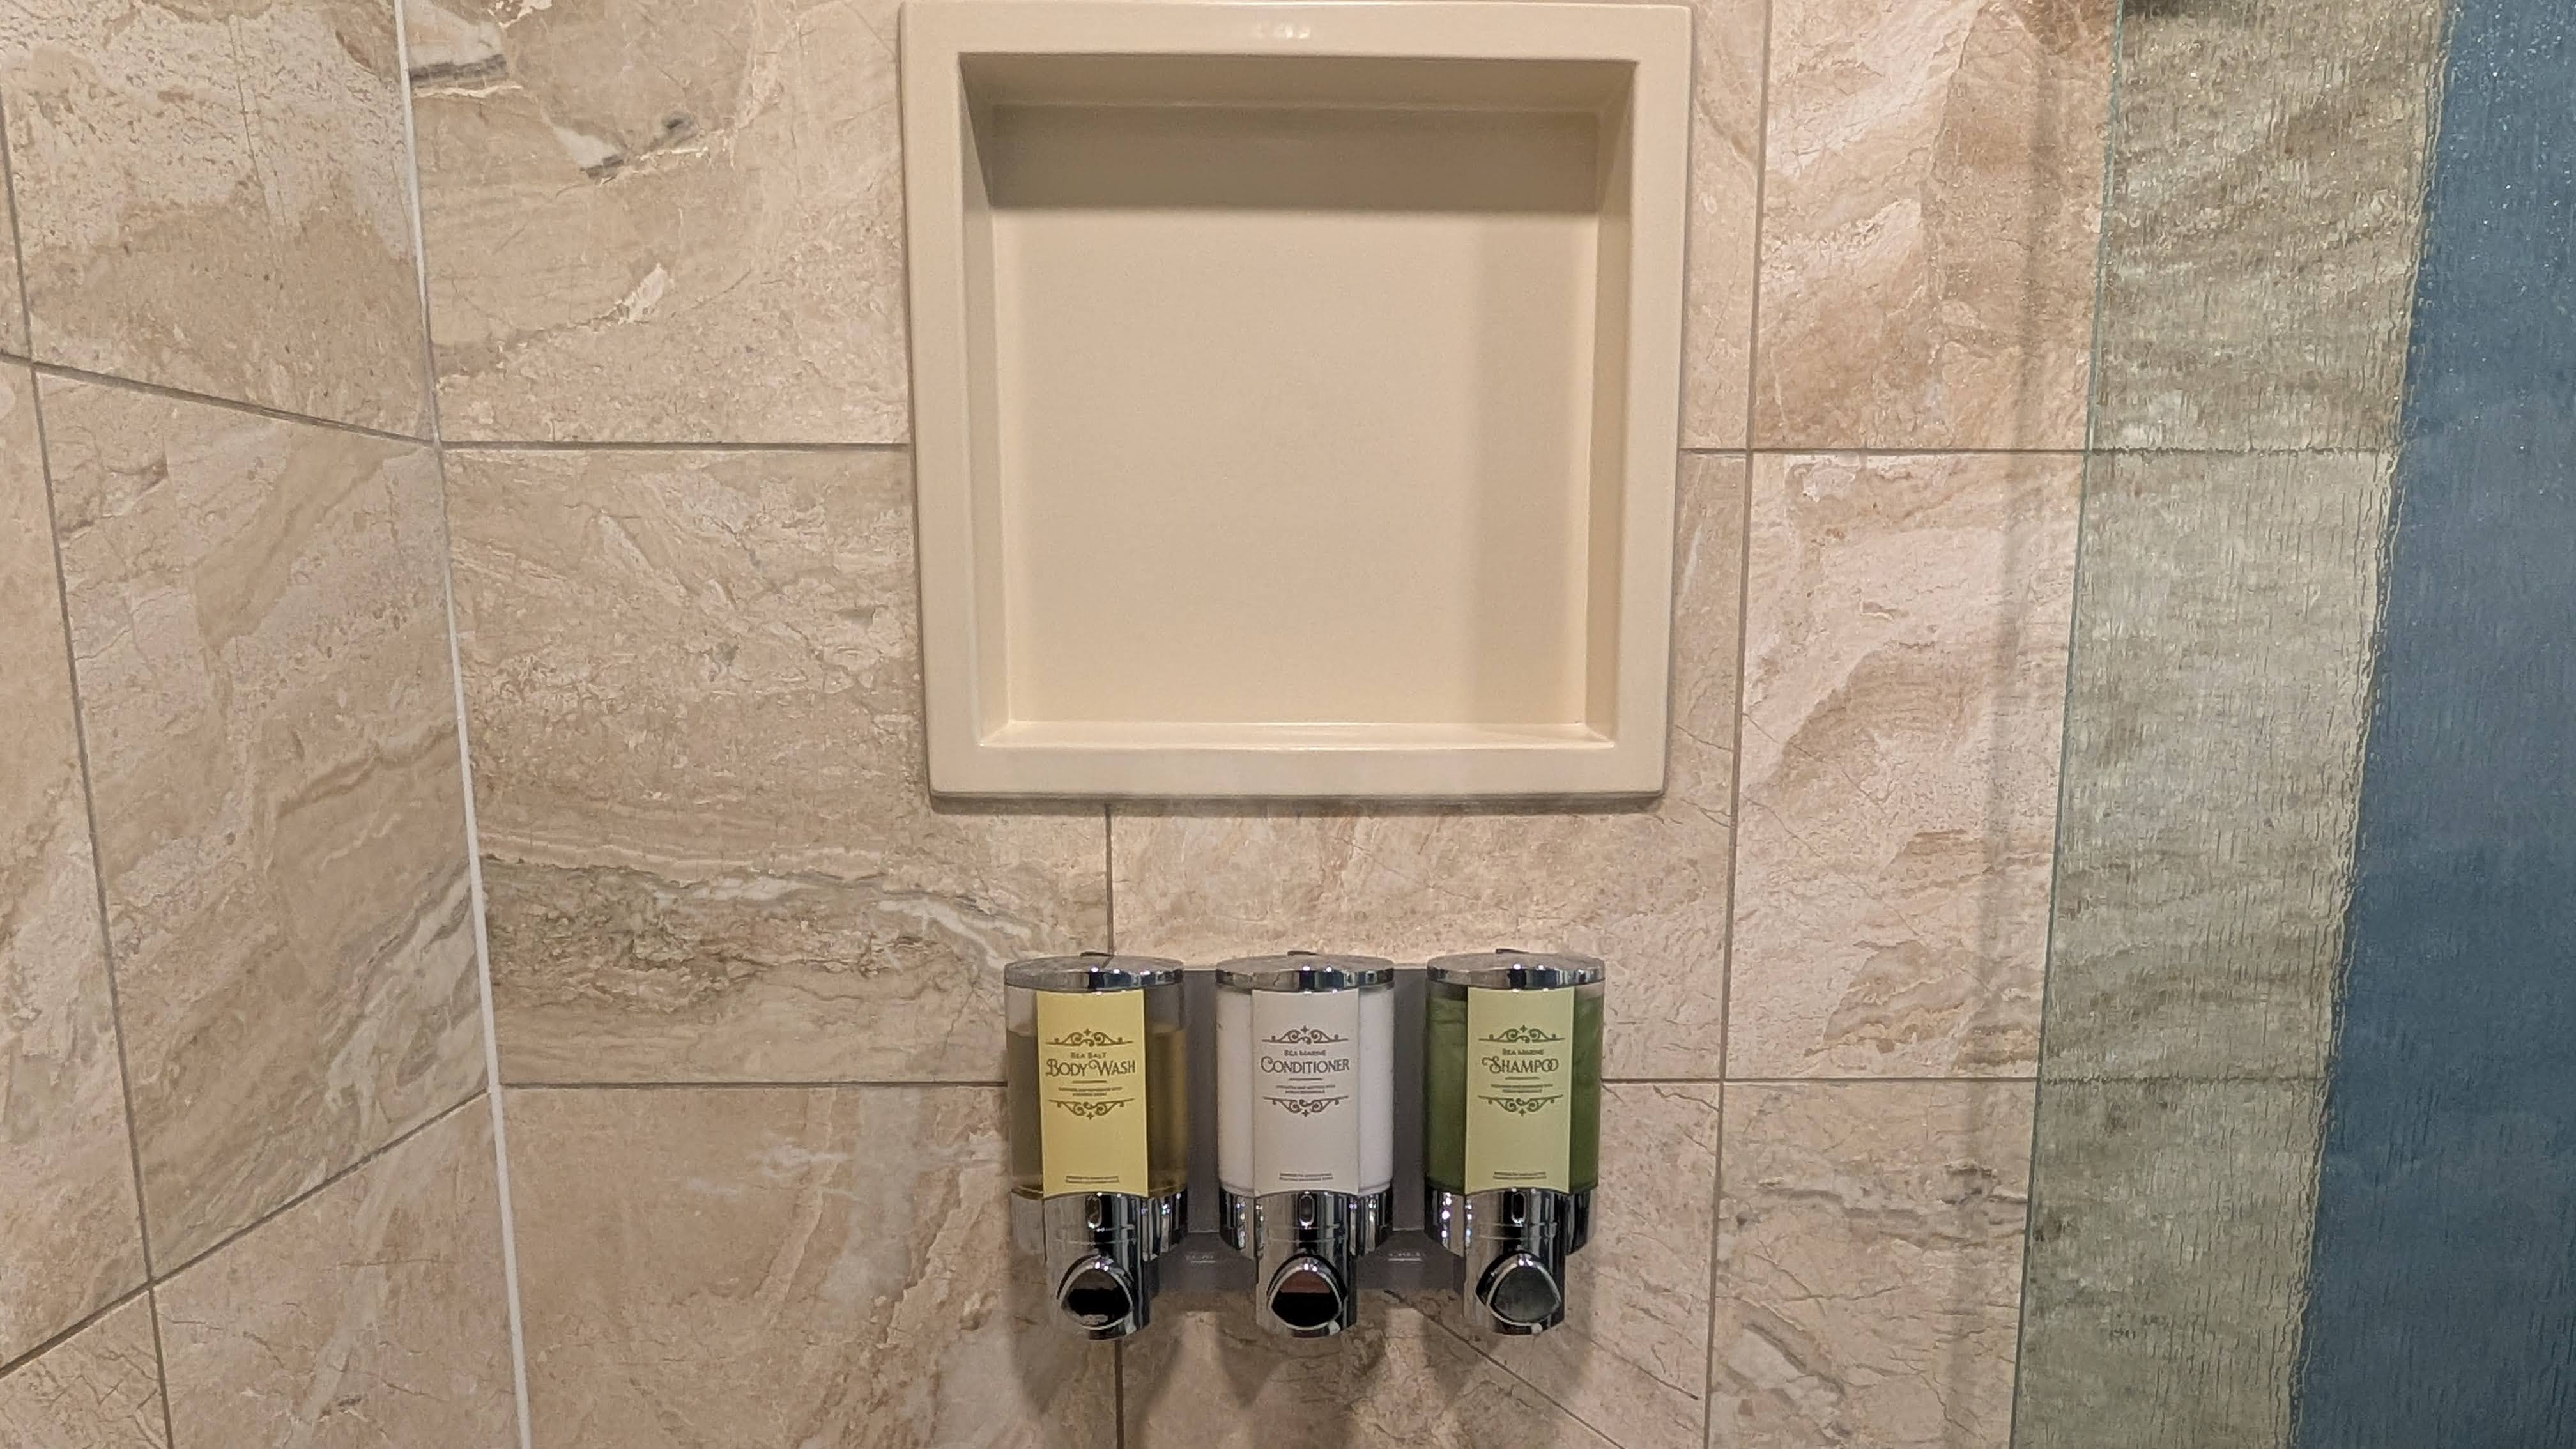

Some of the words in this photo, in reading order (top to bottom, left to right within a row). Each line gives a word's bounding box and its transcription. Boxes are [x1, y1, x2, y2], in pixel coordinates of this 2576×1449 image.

[1046, 1058, 1087, 1077] BODY
[1088, 1059, 1135, 1077] WASH
[1261, 1055, 1349, 1073] CONDITIONER
[1482, 1055, 1559, 1074] SHAMPOO
